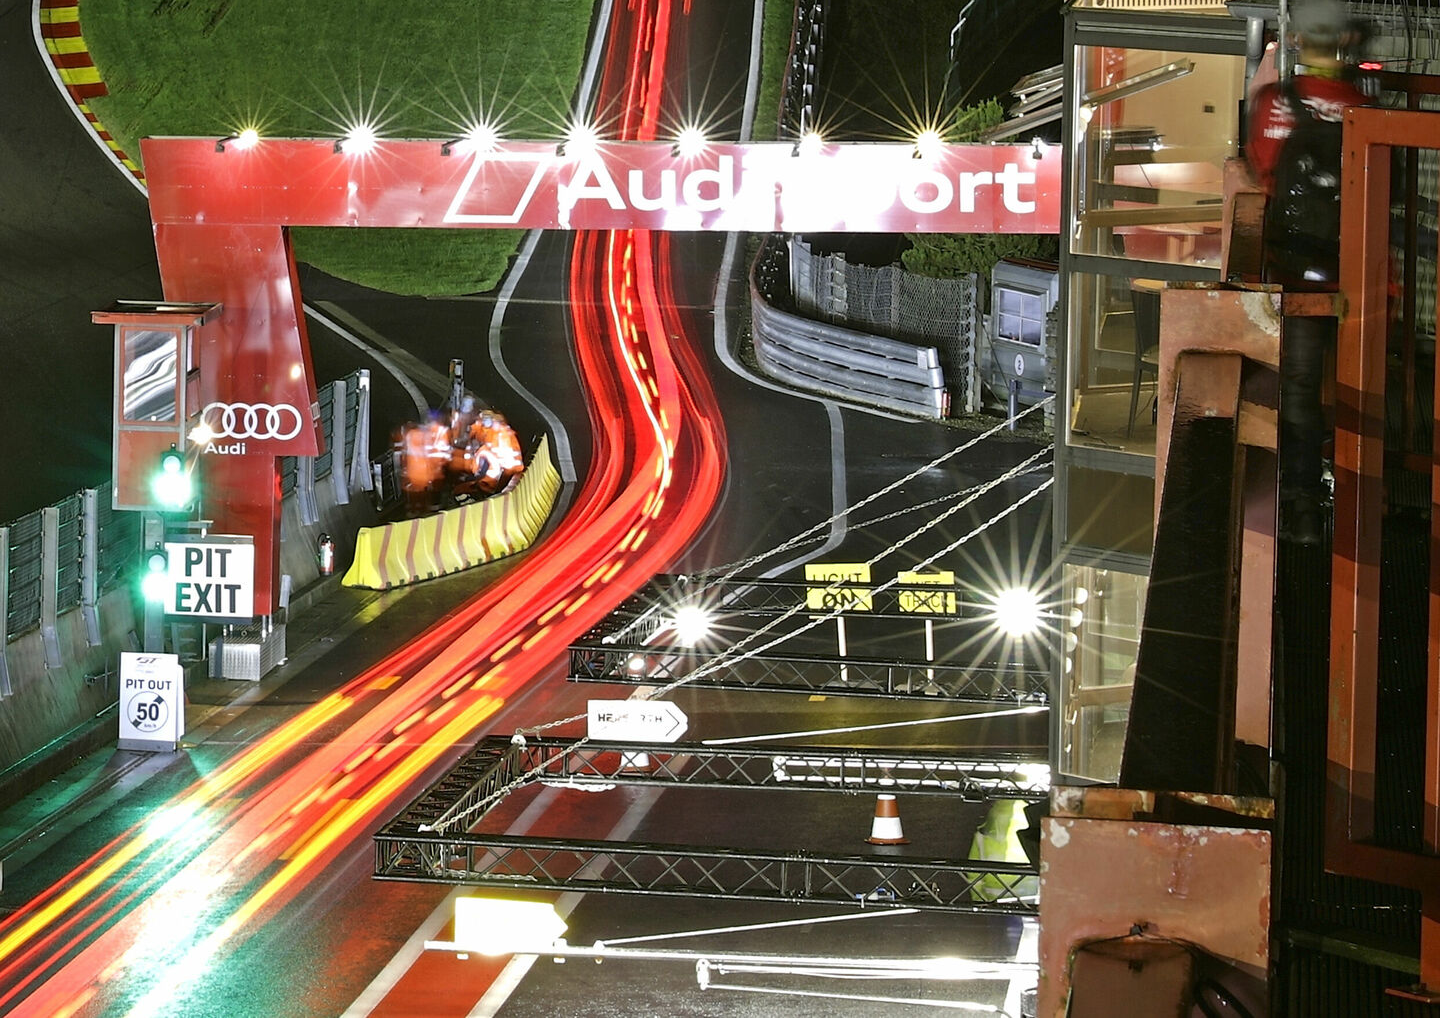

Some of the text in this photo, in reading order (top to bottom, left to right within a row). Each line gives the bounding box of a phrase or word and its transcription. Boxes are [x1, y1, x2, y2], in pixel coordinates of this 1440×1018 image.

[204, 442, 246, 455] Audi
[185, 547, 232, 578] PIT
[175, 583, 242, 614] EXIT
[126, 679, 172, 690] PIT OUT
[137, 703, 159, 721] 50
